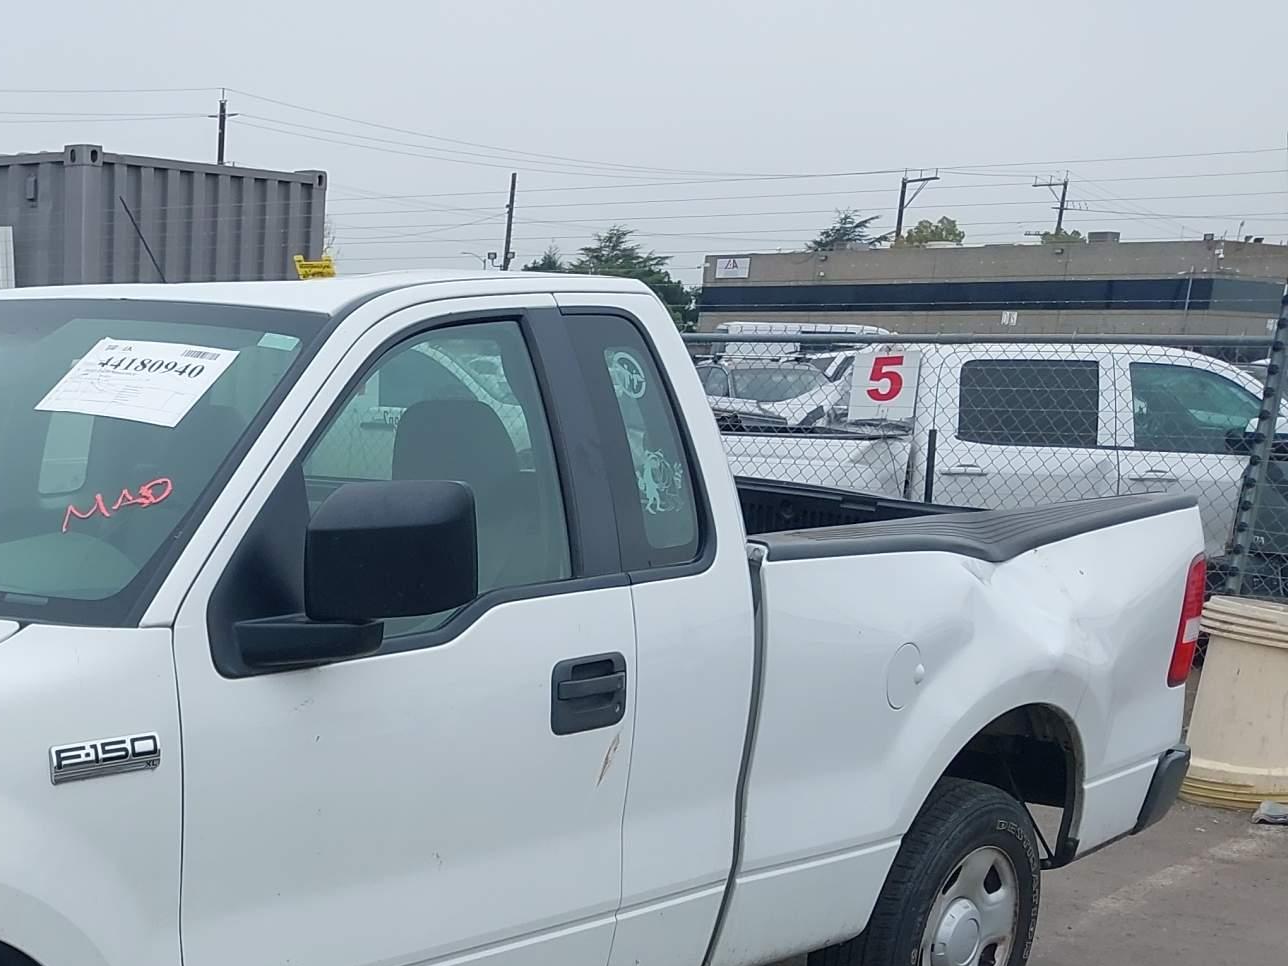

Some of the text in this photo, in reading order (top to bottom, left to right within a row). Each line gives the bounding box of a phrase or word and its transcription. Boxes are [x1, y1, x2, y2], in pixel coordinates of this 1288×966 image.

[98, 356, 206, 379] 44180940
[866, 355, 904, 402] 5
[51, 731, 160, 771] F-150
